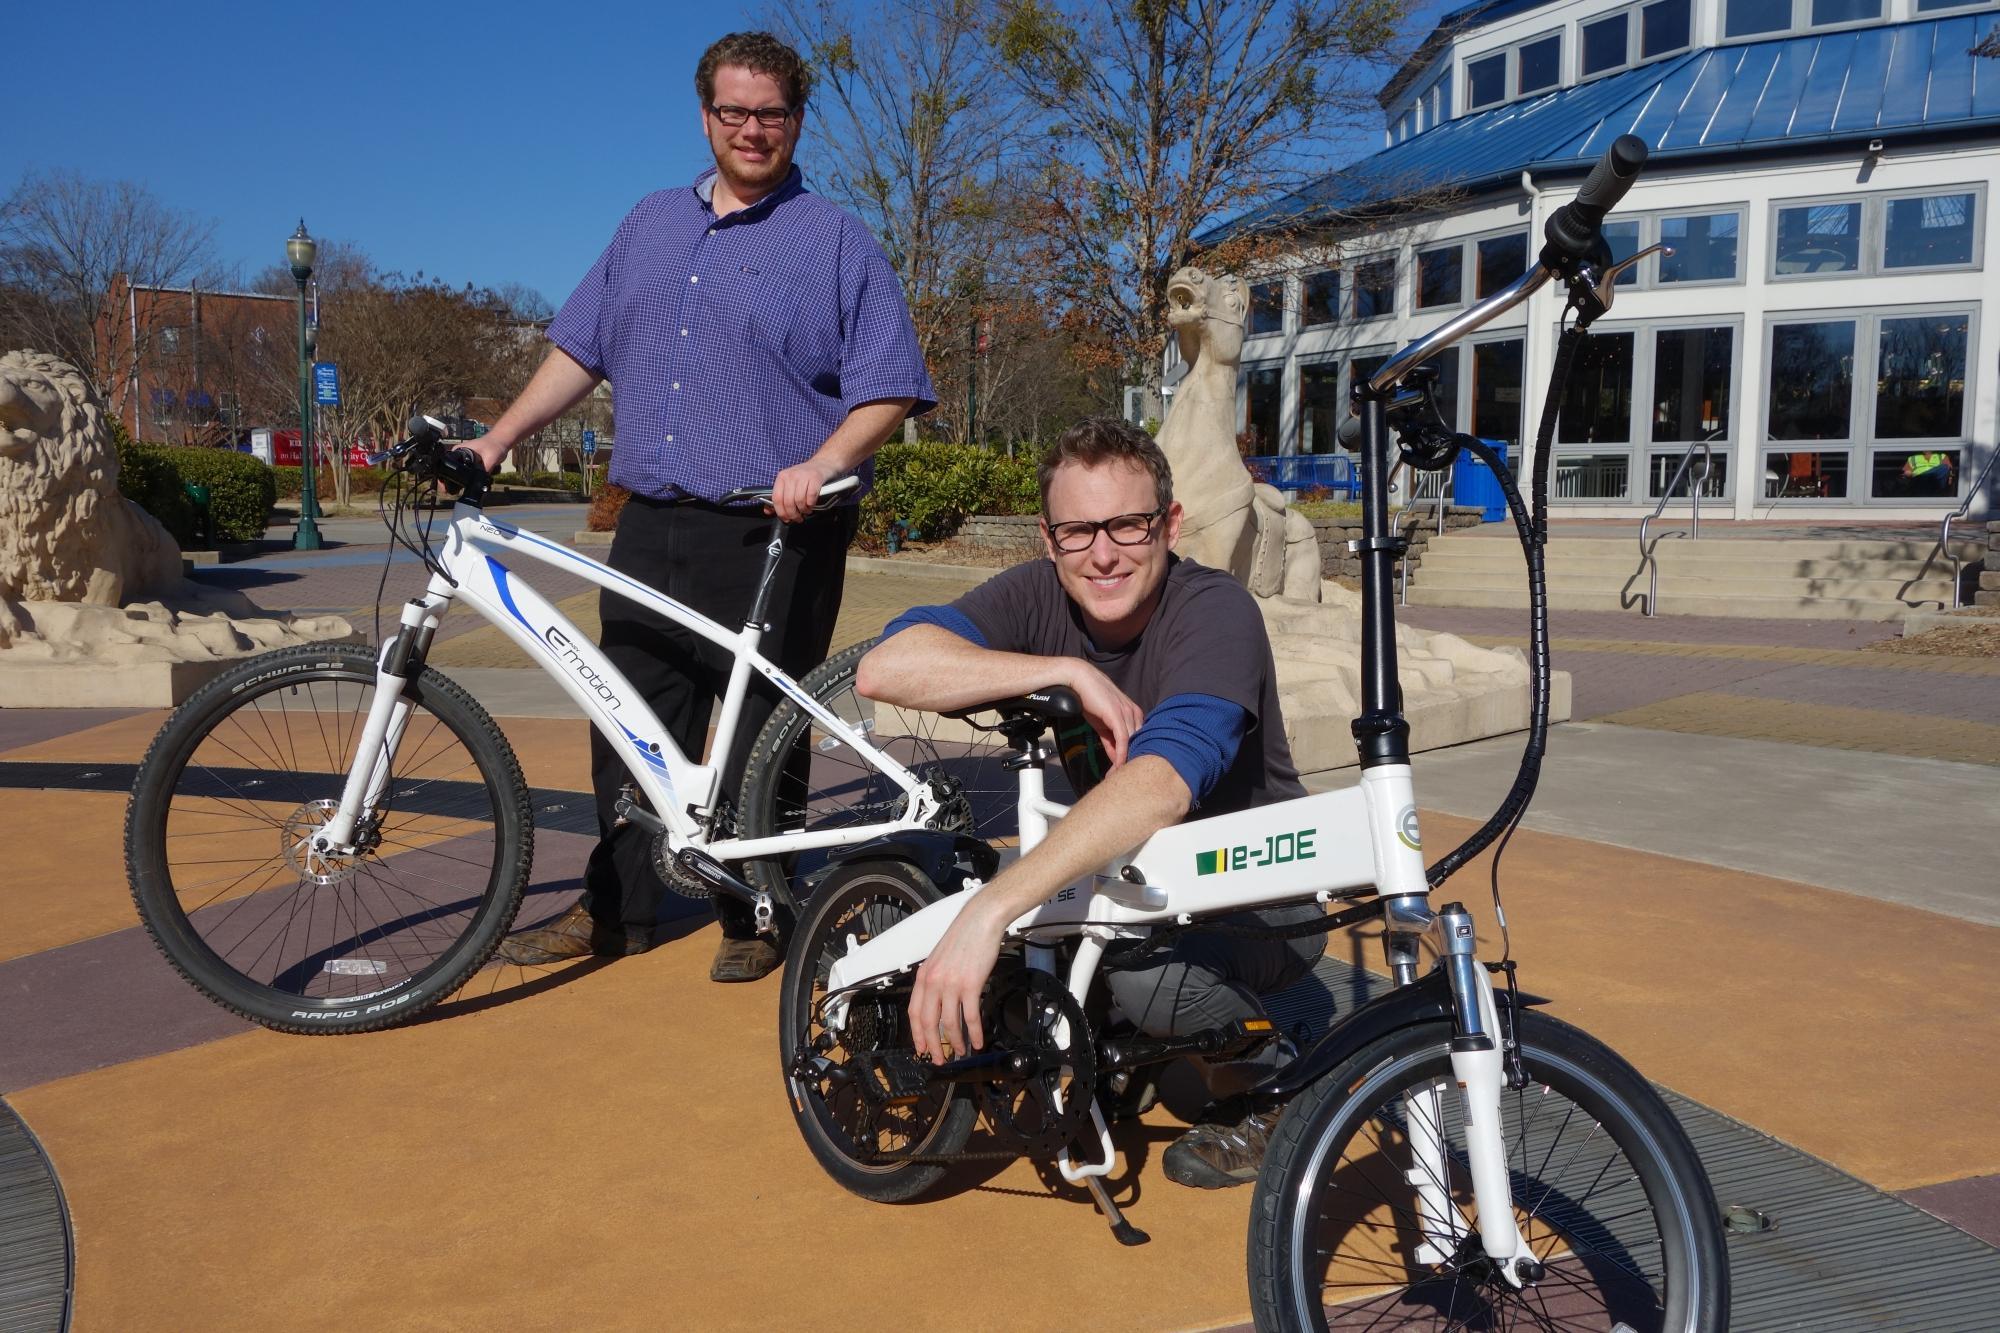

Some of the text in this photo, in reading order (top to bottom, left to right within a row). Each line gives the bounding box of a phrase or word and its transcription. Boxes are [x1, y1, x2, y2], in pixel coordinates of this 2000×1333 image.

[480, 524, 502, 536] NEO
[231, 662, 345, 695] SCHWALBE
[1232, 828, 1317, 871] e-JOE
[1057, 887, 1077, 902] SE
[291, 1009, 358, 1020] RAPID
[366, 993, 410, 1015] ROB
